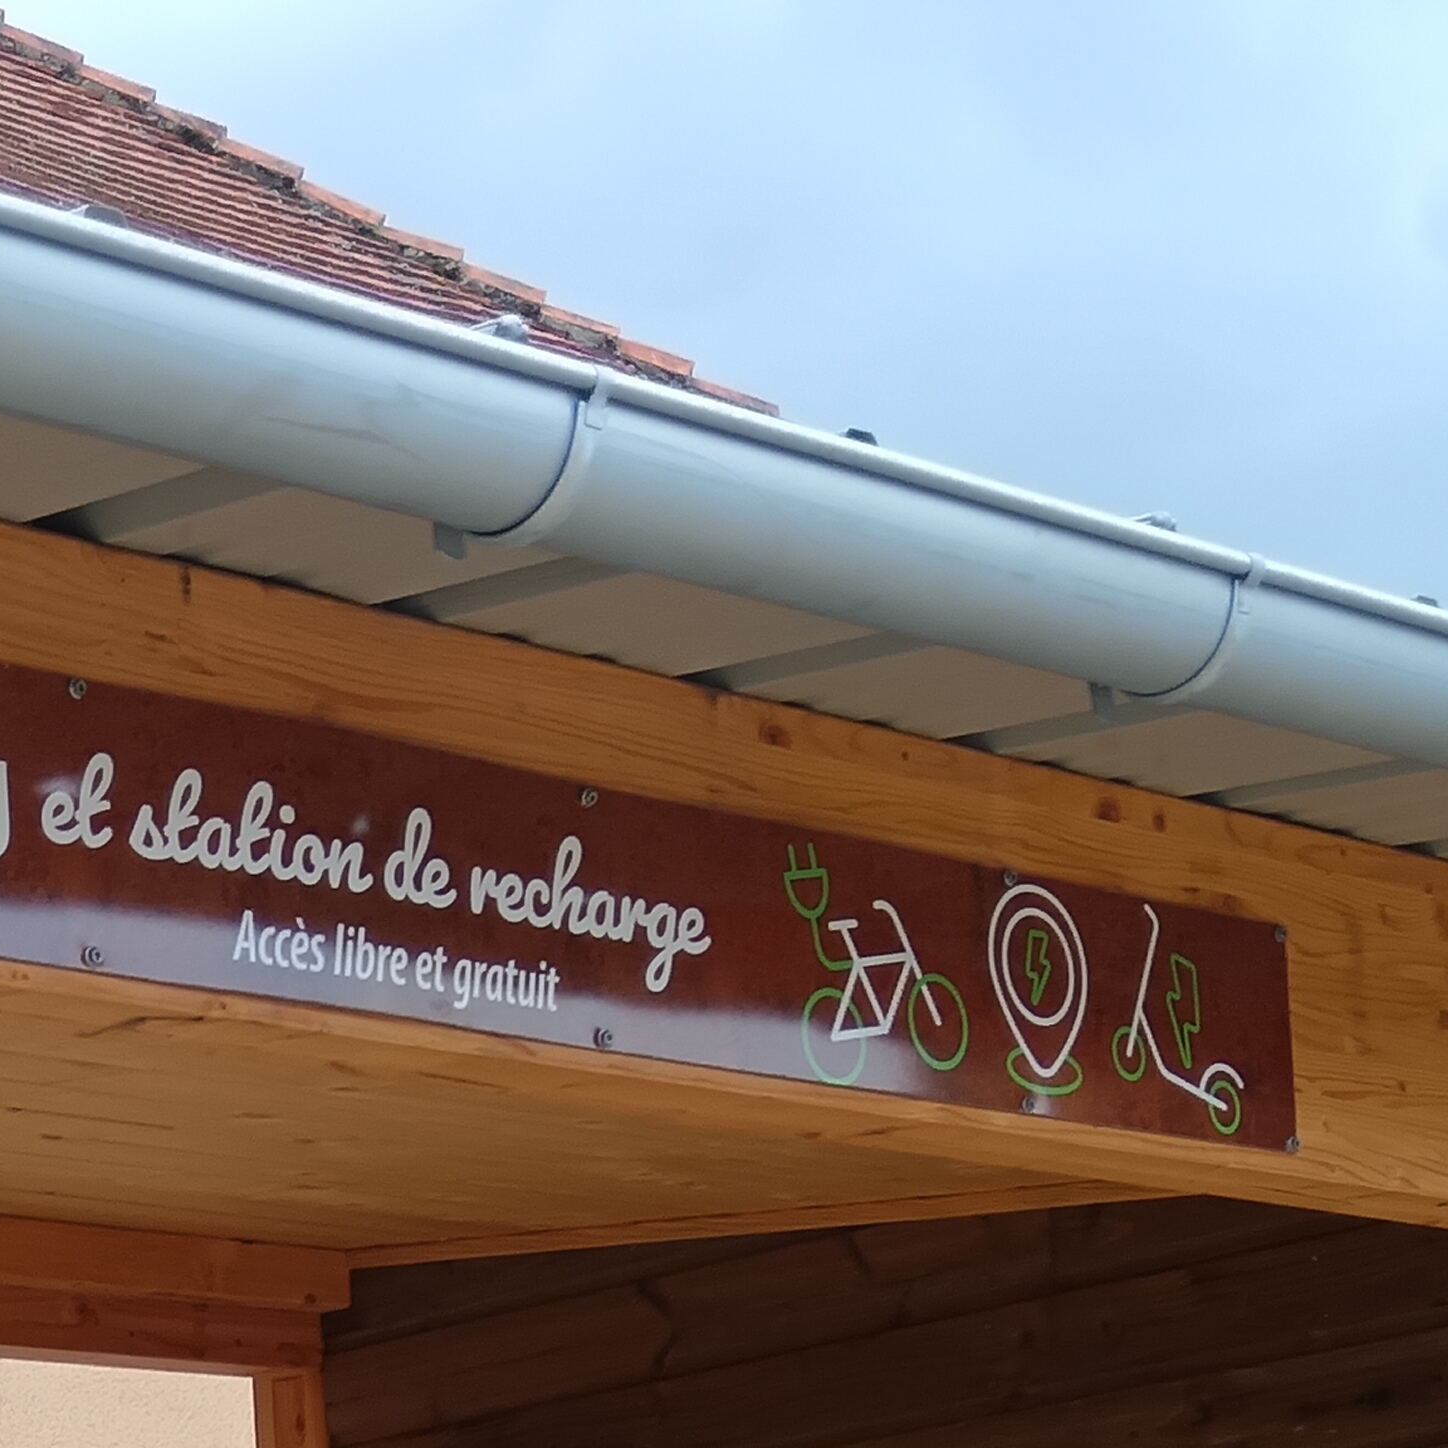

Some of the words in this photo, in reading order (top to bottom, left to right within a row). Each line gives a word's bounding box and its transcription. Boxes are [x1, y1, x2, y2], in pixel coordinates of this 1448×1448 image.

[41, 752, 114, 849] et
[129, 767, 373, 893] station
[384, 807, 457, 908] de
[470, 835, 711, 992] recharge
[232, 909, 325, 974] Accès
[333, 922, 407, 986] libre
[414, 944, 448, 993] et
[453, 957, 560, 1011] gratuit
